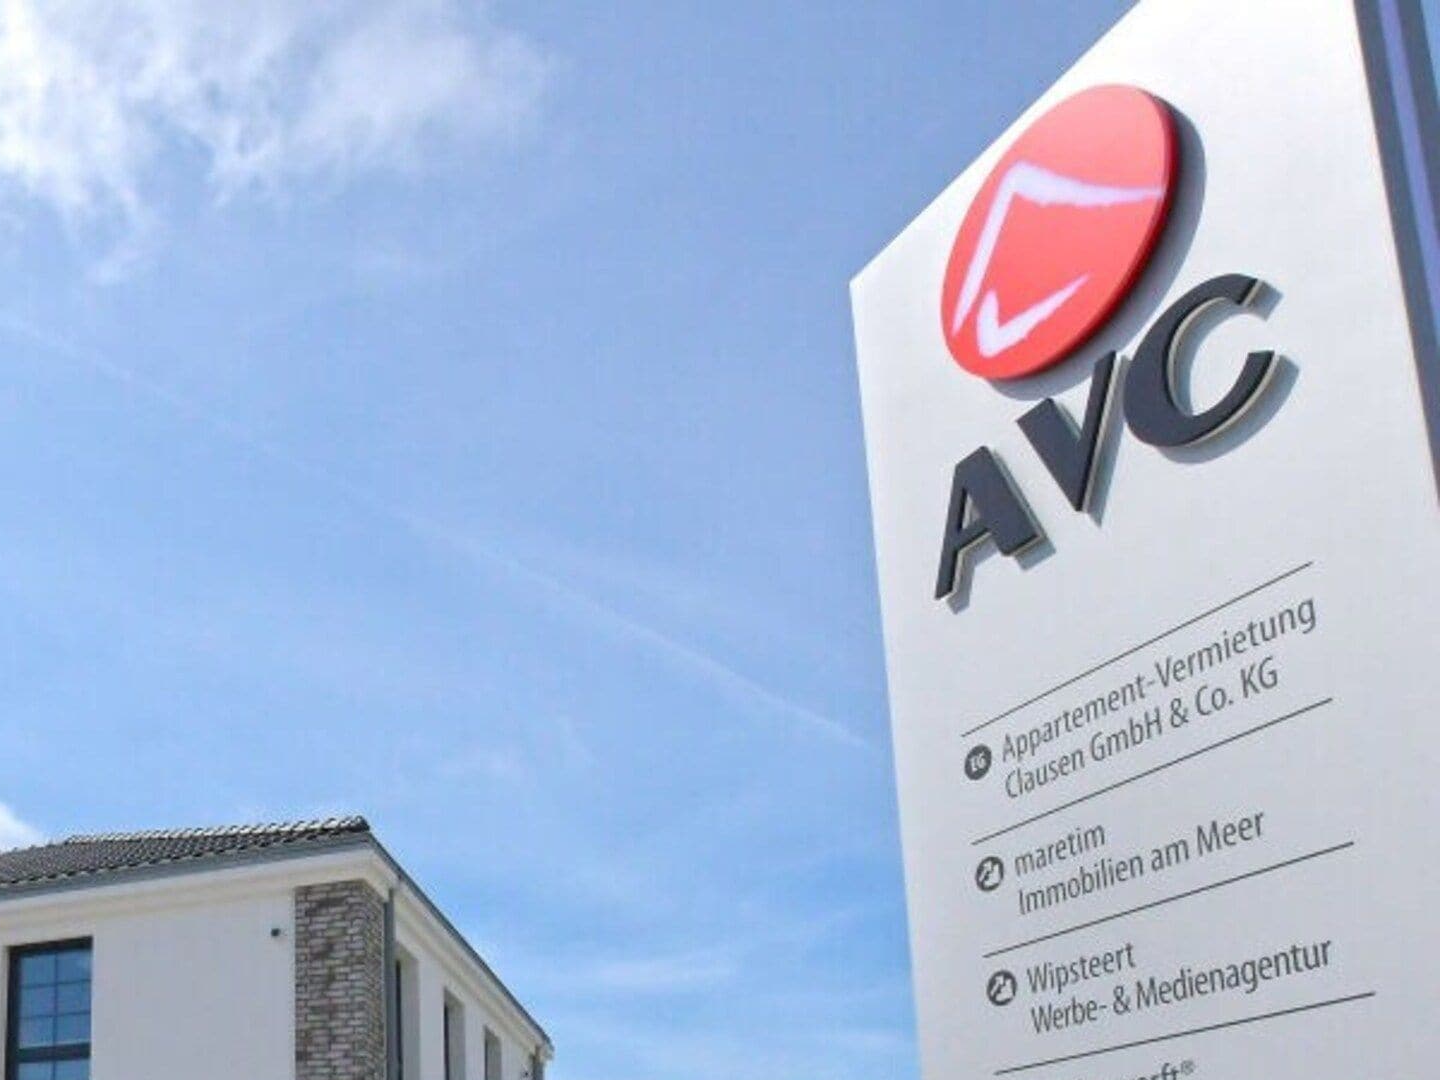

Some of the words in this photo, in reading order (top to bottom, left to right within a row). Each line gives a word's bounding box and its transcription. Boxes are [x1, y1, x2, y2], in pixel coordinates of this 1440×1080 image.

[935, 272, 1277, 602] AVC
[1001, 596, 1318, 762] Appartement-Vermietung
[1005, 746, 1085, 798] Clausen
[1089, 704, 1163, 764] GmbH
[1169, 698, 1190, 727] &
[1194, 683, 1234, 719] Co.
[1241, 656, 1279, 699] KG
[1014, 822, 1106, 877] maretim
[1018, 858, 1145, 916] Immobilien
[1150, 840, 1191, 871] am
[1196, 811, 1265, 856] Meer
[1026, 941, 1136, 995] Wipsteert
[1031, 1000, 1108, 1034] Werbe-
[1112, 985, 1132, 1015] &
[1135, 939, 1332, 1011] Medienagentur
